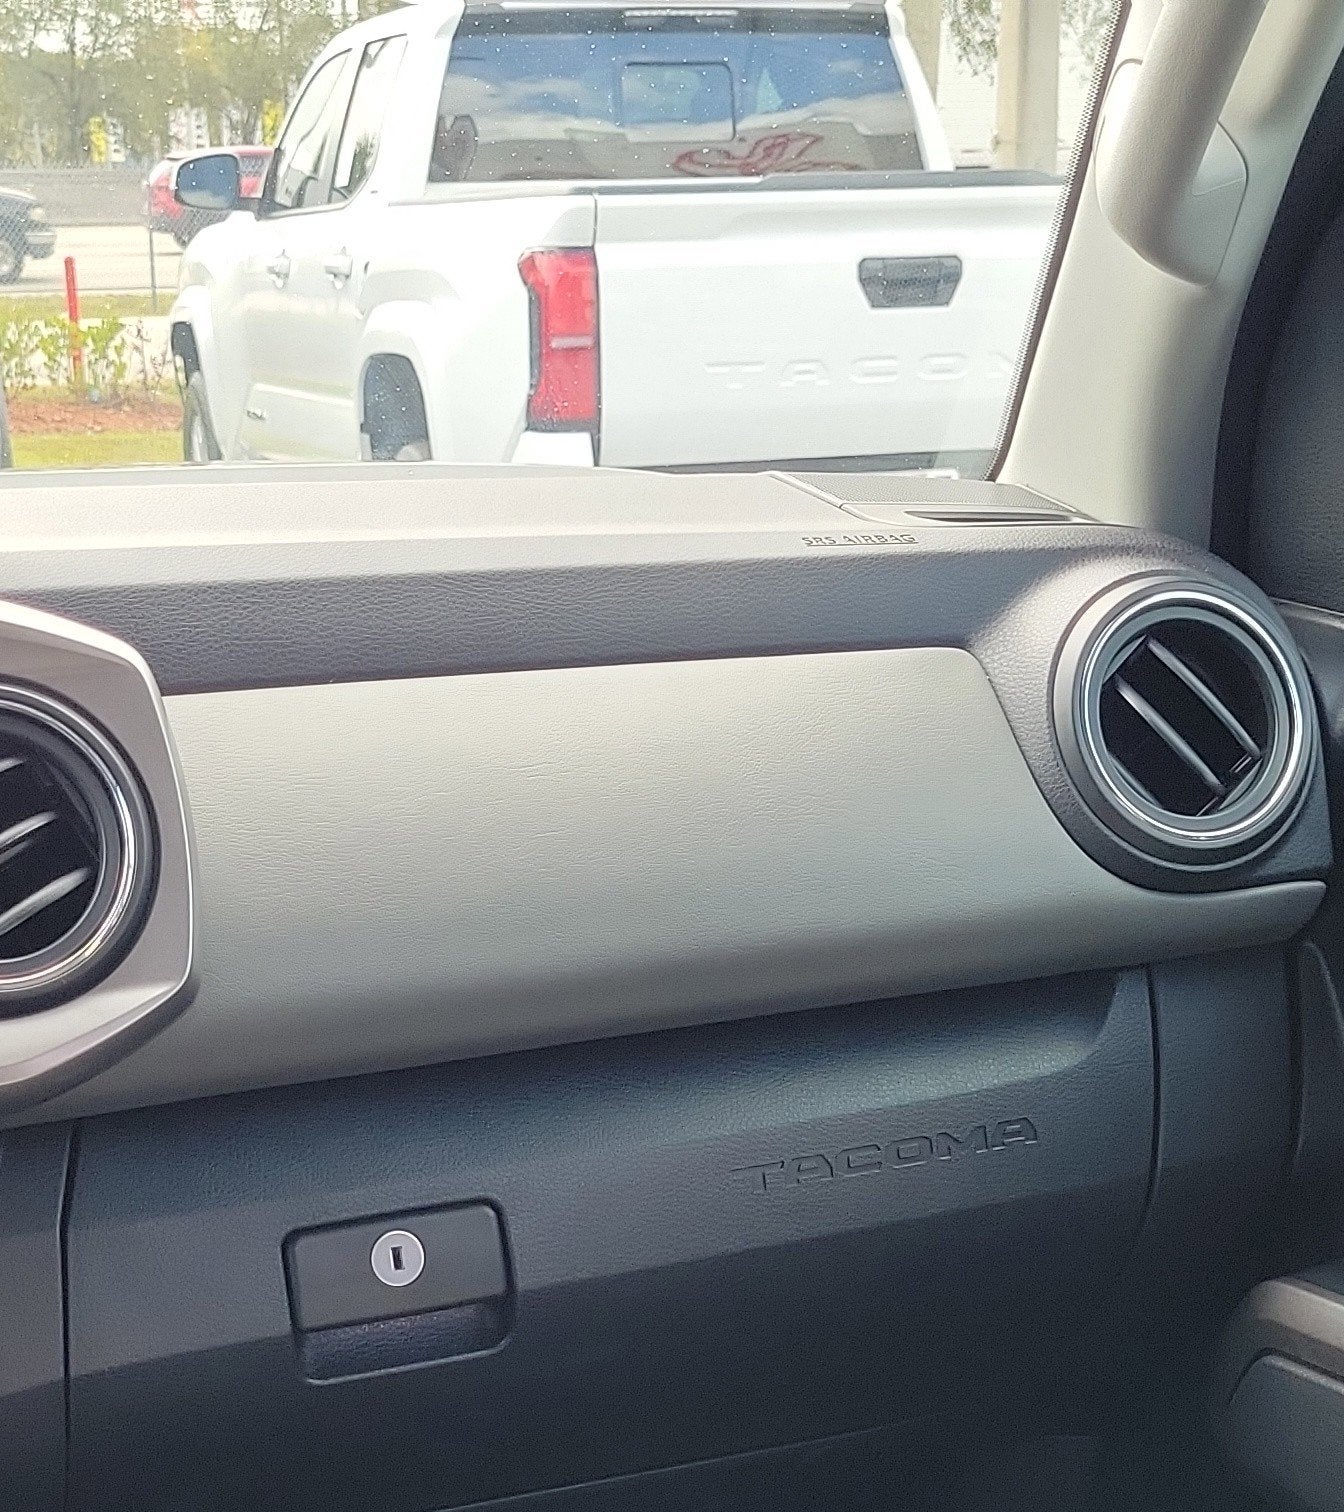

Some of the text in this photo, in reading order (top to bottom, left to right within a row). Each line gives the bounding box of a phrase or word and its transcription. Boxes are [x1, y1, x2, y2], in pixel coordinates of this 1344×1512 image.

[801, 534, 916, 545] SRS AIRBAG
[728, 1115, 1039, 1193] TACOMA
